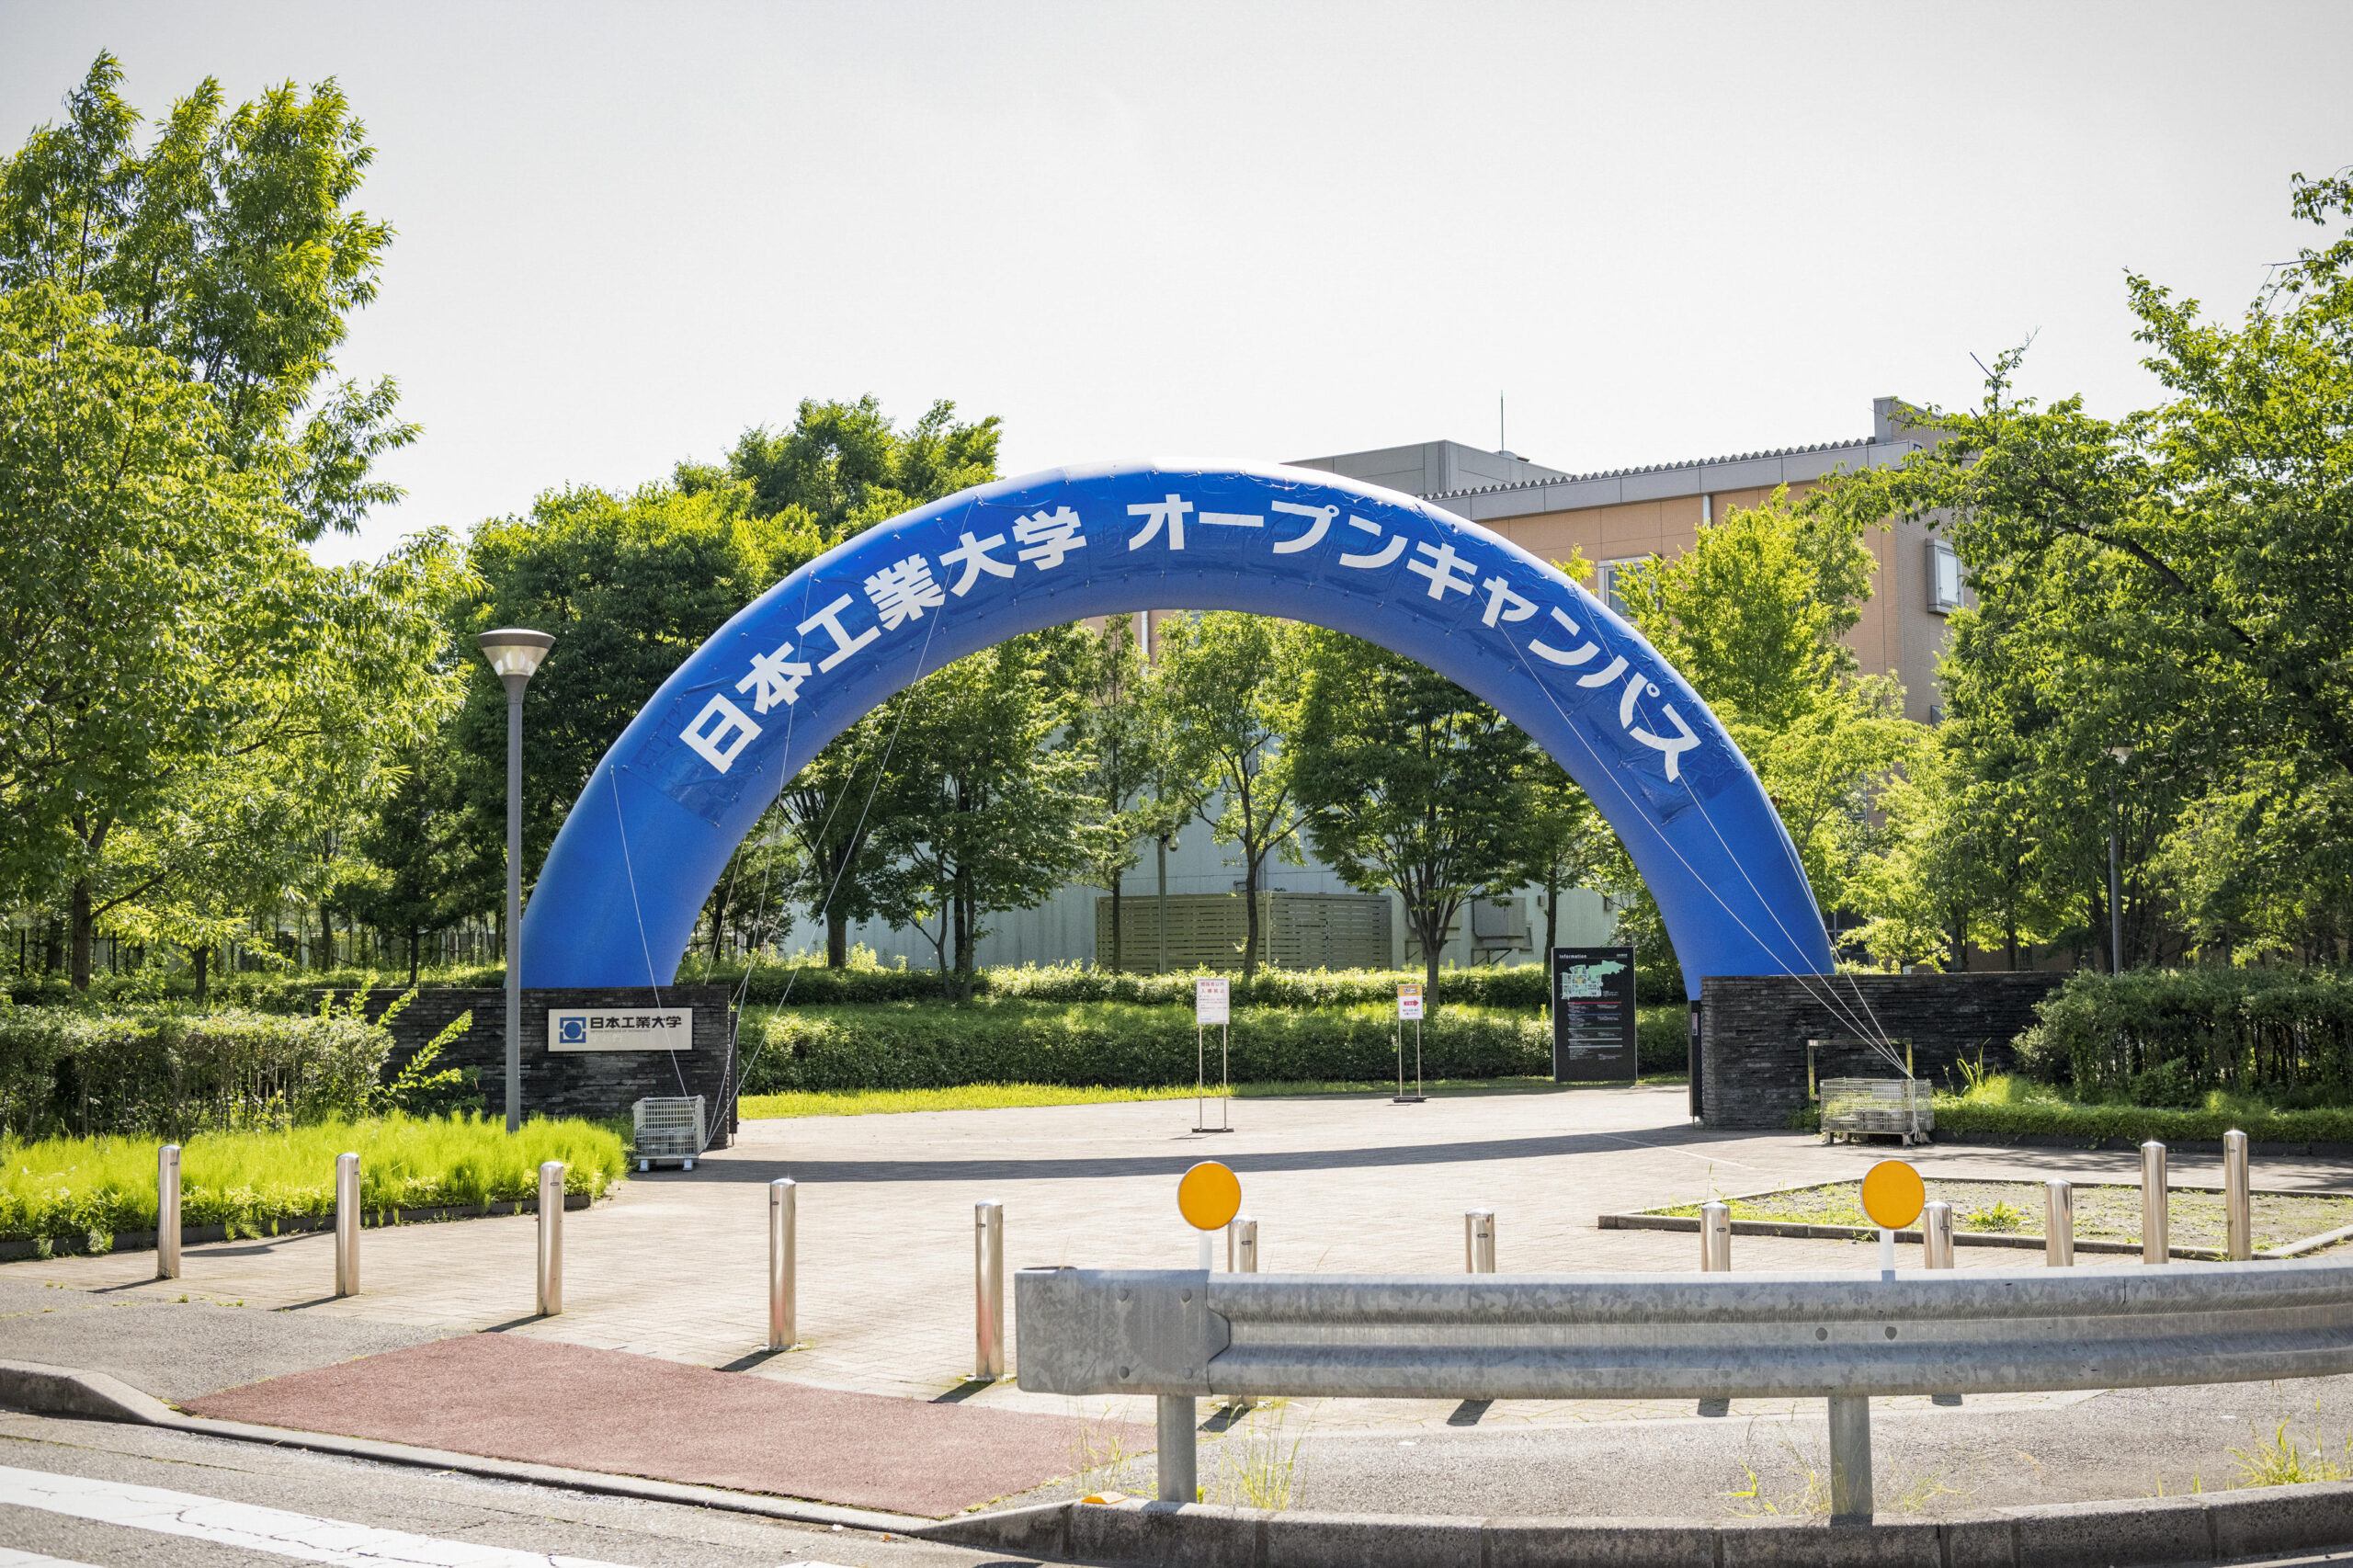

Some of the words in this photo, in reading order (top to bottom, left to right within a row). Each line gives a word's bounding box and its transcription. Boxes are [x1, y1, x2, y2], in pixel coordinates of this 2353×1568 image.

[678, 505, 1087, 775] 日本工業大学
[1127, 494, 1703, 783] オープンキャンパス
[590, 1016, 682, 1028] 日本工業大学
